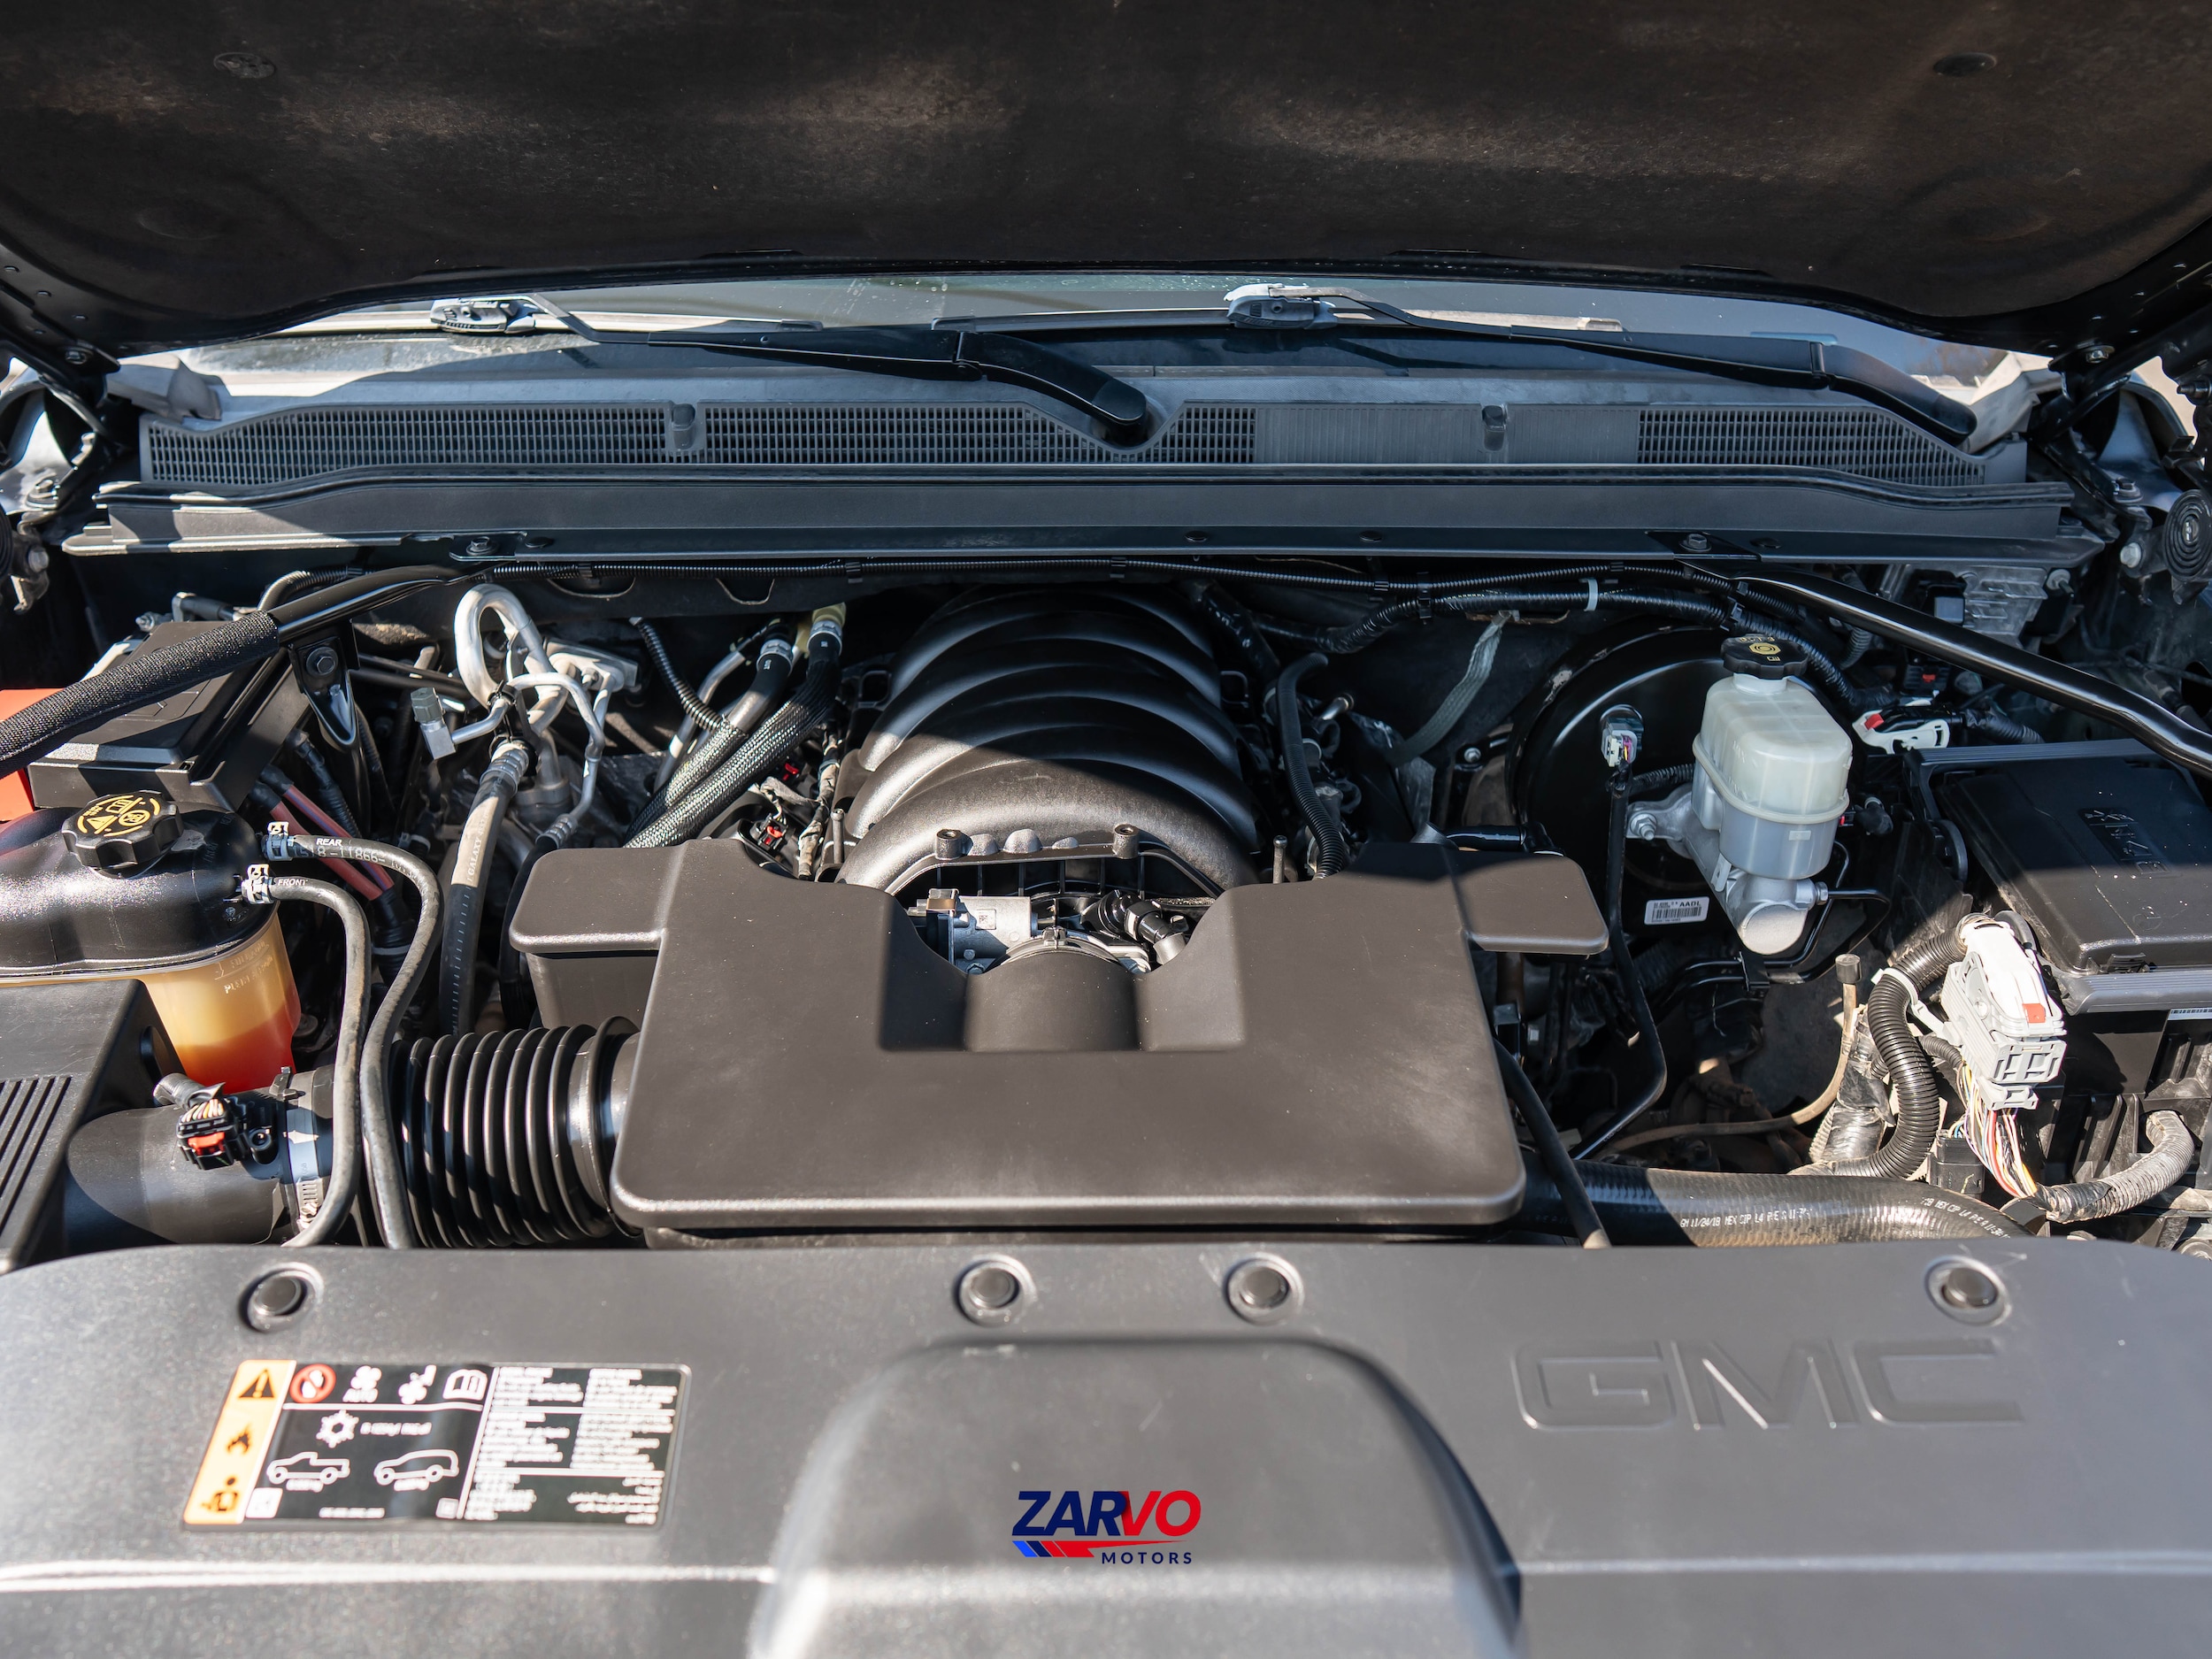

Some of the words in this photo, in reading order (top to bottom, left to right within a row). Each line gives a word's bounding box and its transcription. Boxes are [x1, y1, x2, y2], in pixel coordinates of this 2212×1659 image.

[316, 838, 342, 848] REAR
[467, 837, 482, 876] GALAXY
[278, 878, 307, 887] FRONT
[1510, 1339, 2025, 1430] GMC
